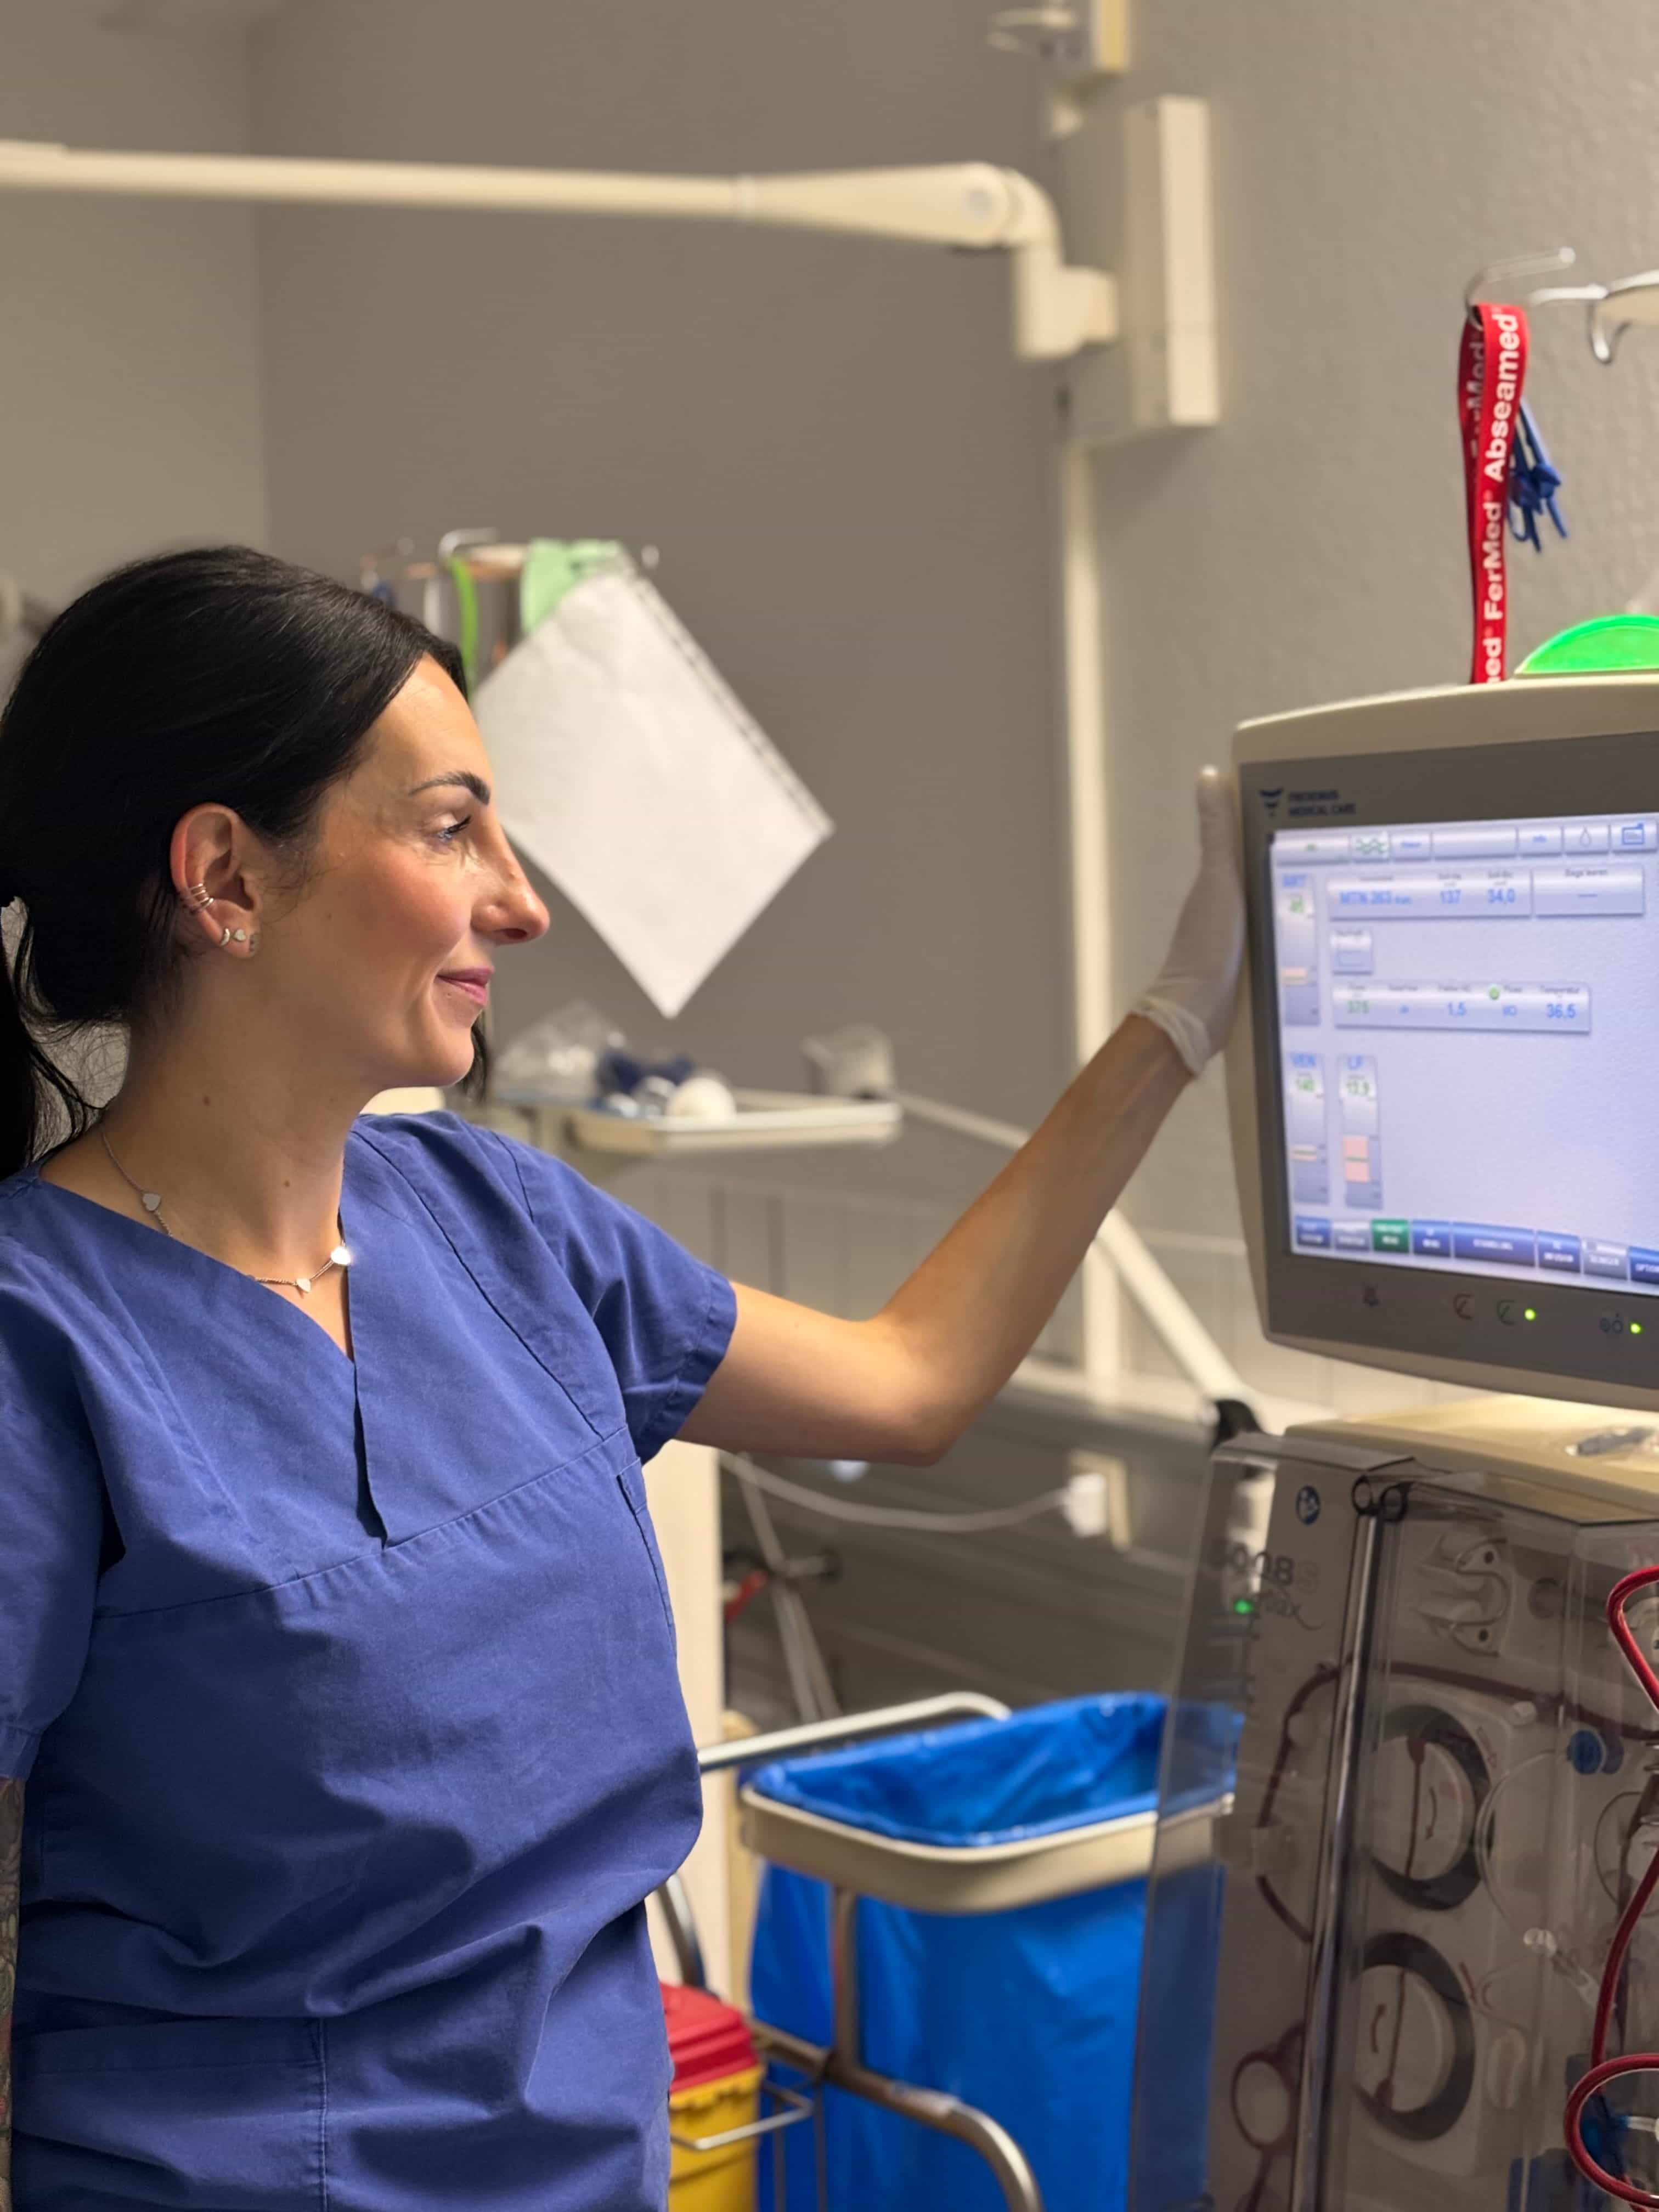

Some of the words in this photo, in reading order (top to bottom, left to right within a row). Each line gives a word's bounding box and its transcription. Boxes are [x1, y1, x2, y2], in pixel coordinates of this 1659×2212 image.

[1484, 313, 1520, 482] Abseamed
[1482, 501, 1504, 621] FerMed
[1482, 637, 1502, 683] ed
